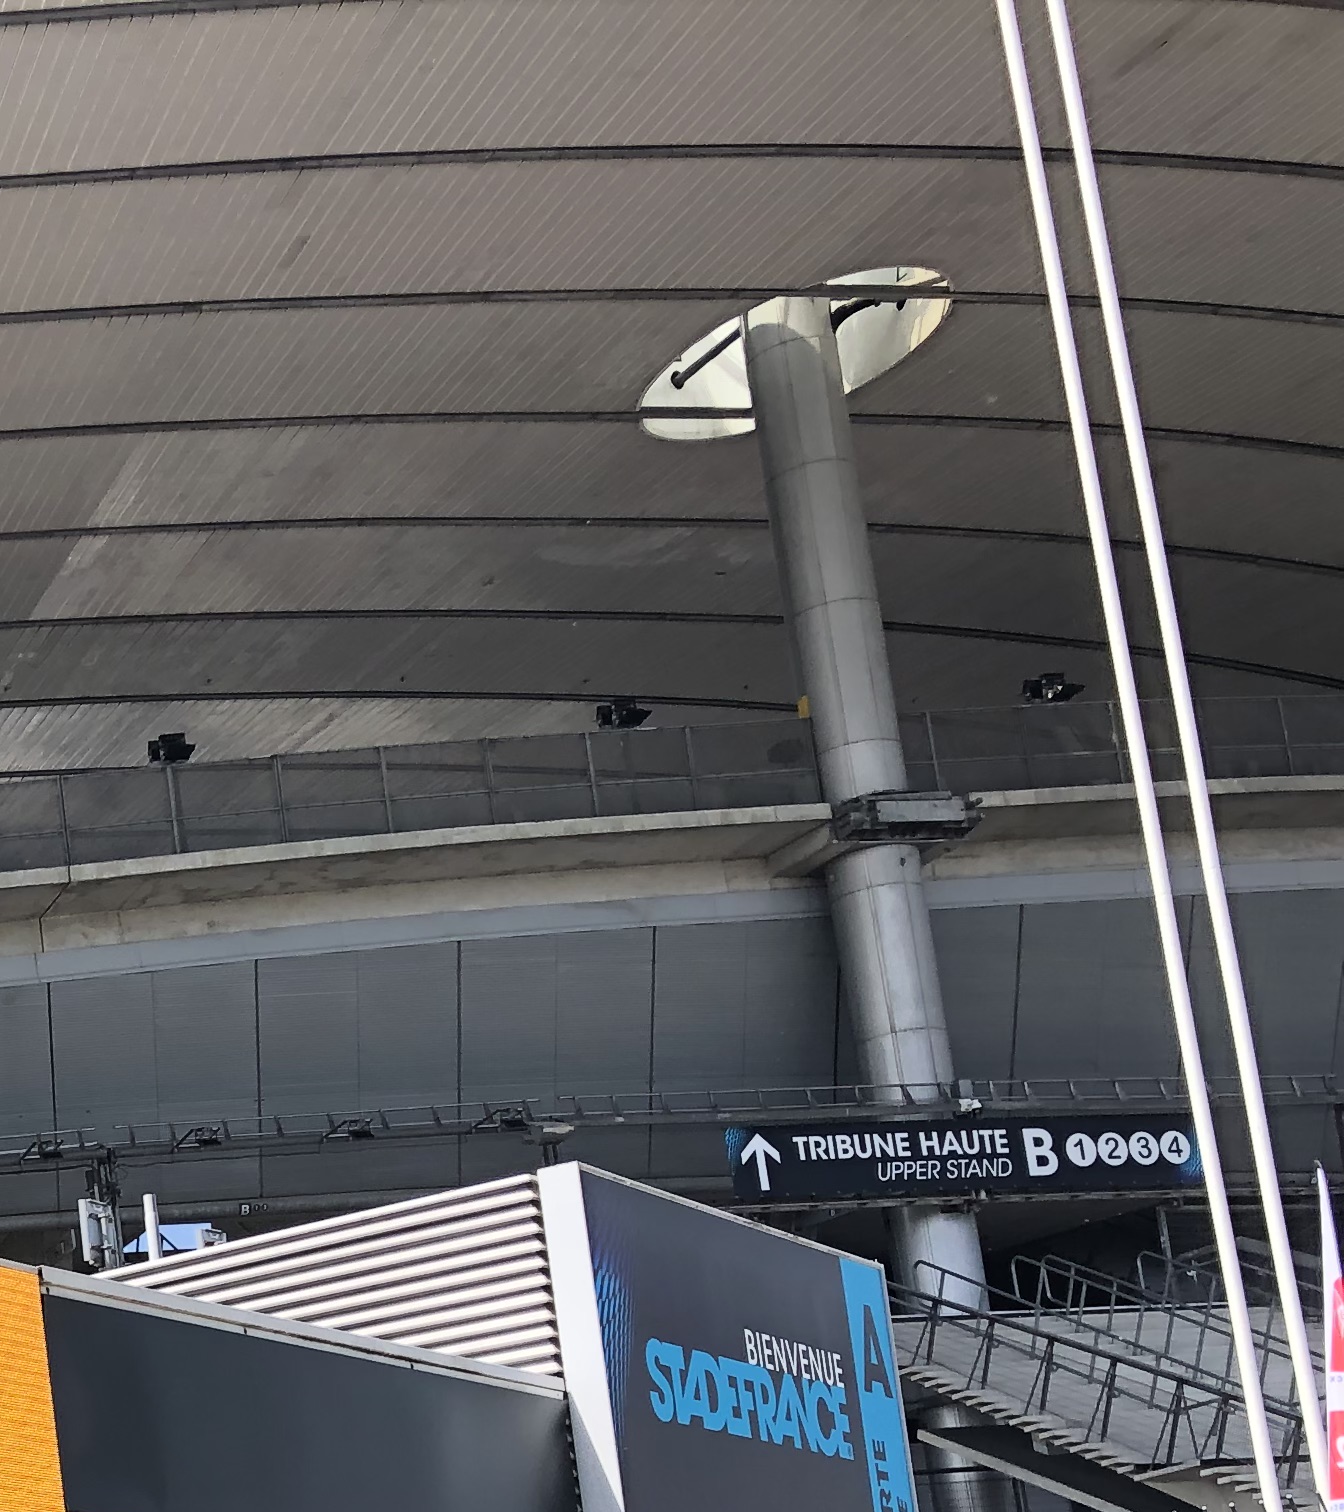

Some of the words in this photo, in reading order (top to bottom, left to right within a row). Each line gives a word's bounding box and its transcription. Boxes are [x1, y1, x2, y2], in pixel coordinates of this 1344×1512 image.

[792, 1132, 911, 1161] TRIBUNE
[919, 1129, 1010, 1156] HAUTE
[1021, 1127, 1059, 1177] B
[877, 1161, 940, 1181] UPPER
[946, 1158, 1012, 1179] STAND
[743, 1328, 845, 1388] BIENVENUE
[862, 1303, 896, 1399] A
